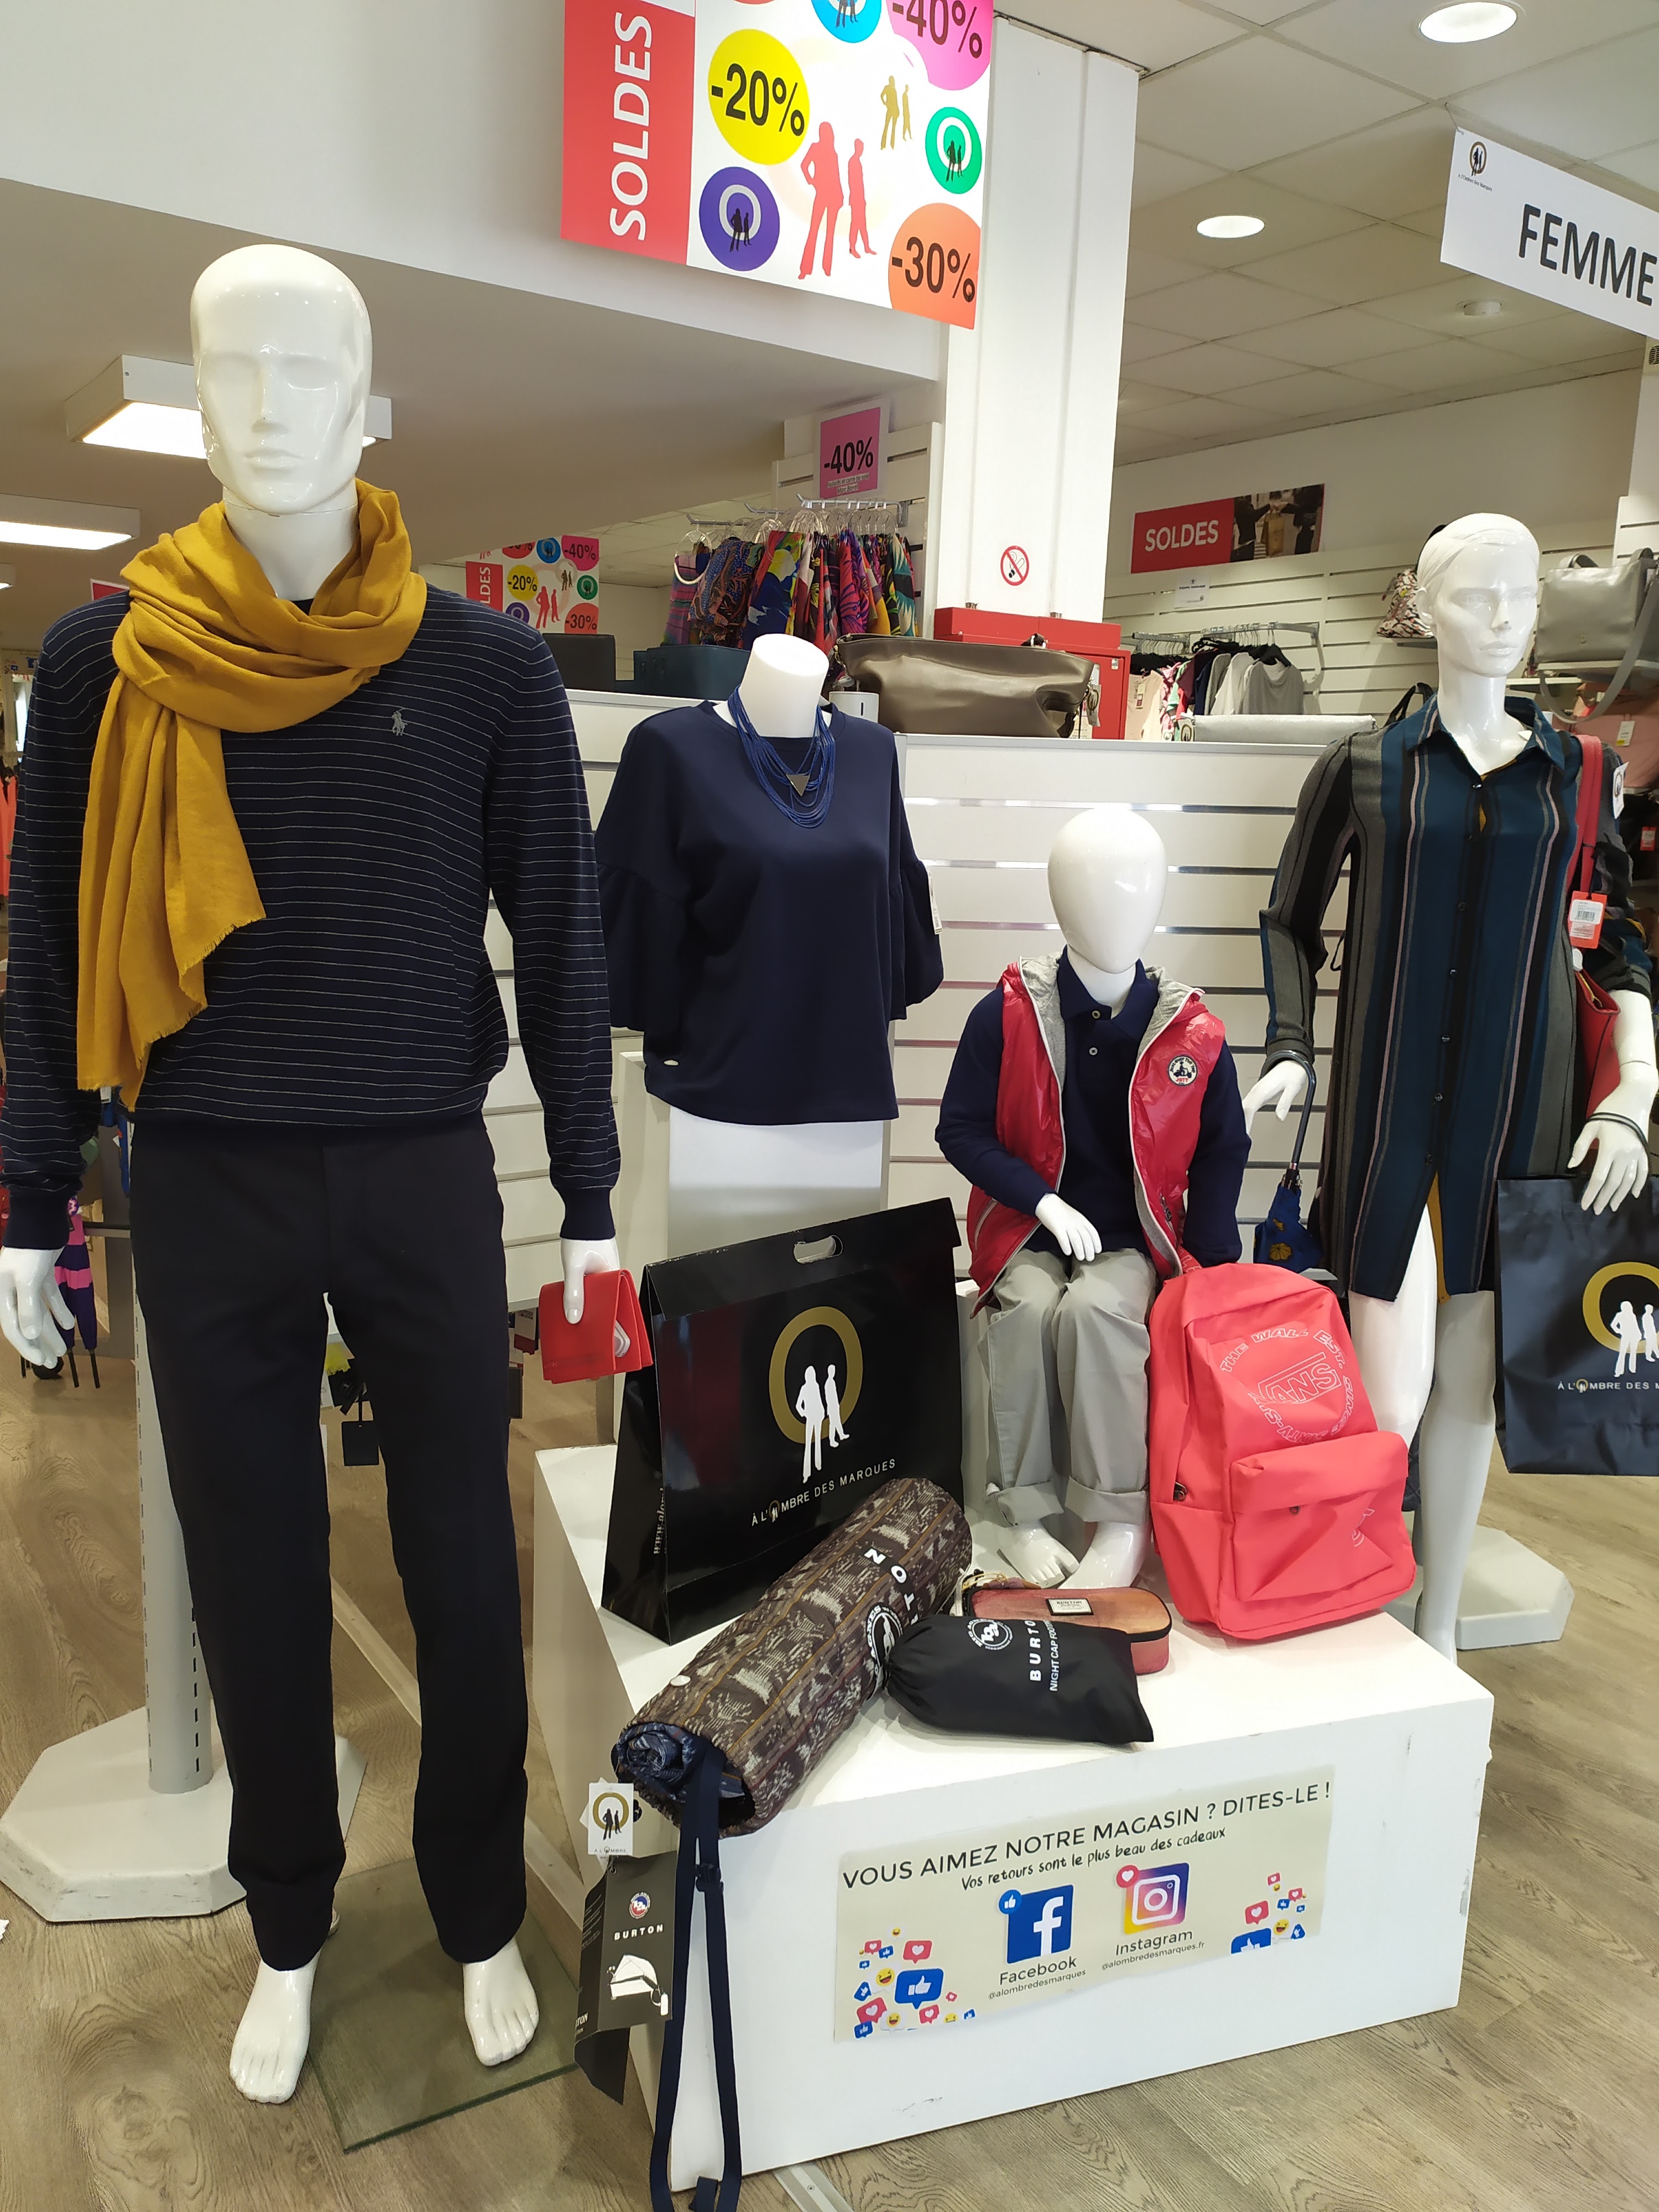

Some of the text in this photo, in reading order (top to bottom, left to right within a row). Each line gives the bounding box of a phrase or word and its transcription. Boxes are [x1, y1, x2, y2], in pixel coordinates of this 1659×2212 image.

[893, 0, 983, 59] -40%
[711, 63, 805, 137] -20%
[610, 12, 653, 241] SOLDES
[891, 237, 975, 304] -30%
[1519, 204, 1657, 306] FEMME
[824, 436, 873, 474] -40%
[564, 543, 596, 560] -40%
[1145, 520, 1219, 552] SOLDES
[479, 566, 491, 604] LDES
[508, 575, 538, 592] -20%
[565, 614, 597, 630] -30%
[1220, 1343, 1249, 1373] THE
[1251, 1328, 1309, 1343] WALL
[1313, 1329, 1345, 1369] EST.
[761, 1491, 810, 1523] L'OMBRE
[815, 1480, 834, 1498] DES
[839, 1458, 896, 1486] MARQUES
[1024, 1620, 1042, 1682] BURTO
[1050, 1640, 1058, 1658] CAP
[1049, 1659, 1060, 1692] NIGHT
[843, 1781, 1330, 1888] VOUS AIMEZ NOTRE MAGASIN ? DITES-LE !
[962, 1827, 1226, 1891] Vos retours sont le plus beau des cadeaux
[614, 1923, 664, 1941] BURTON
[1115, 1931, 1193, 1956] Instagram
[999, 1955, 1077, 1986] Facebook
[1101, 1941, 1206, 1971] @alombredesmarques.fr
[988, 1969, 1087, 2000] @alombredesmarques
